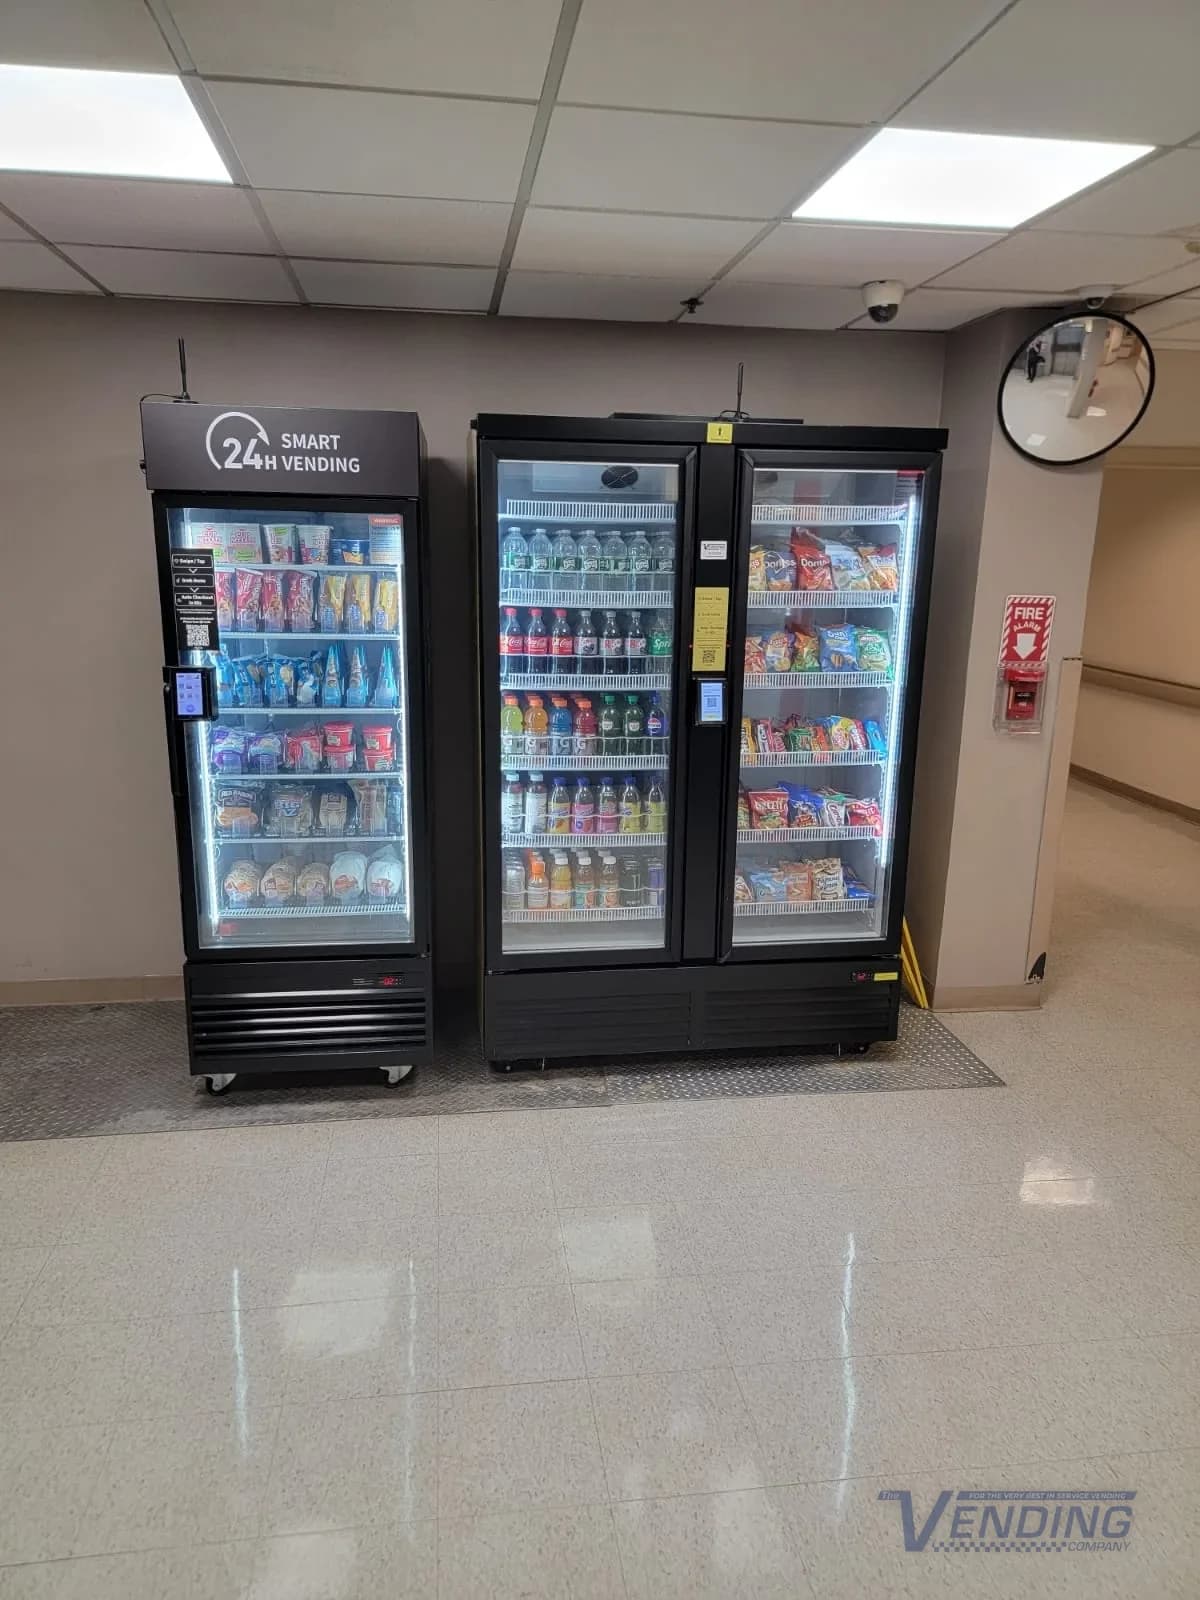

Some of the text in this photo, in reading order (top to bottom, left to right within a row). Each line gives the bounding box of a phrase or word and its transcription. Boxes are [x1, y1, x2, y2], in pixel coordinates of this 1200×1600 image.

[281, 433, 341, 450] SMART
[281, 455, 361, 473] VENDING
[1014, 606, 1045, 620] FIRE
[1013, 620, 1042, 632] ALARM
